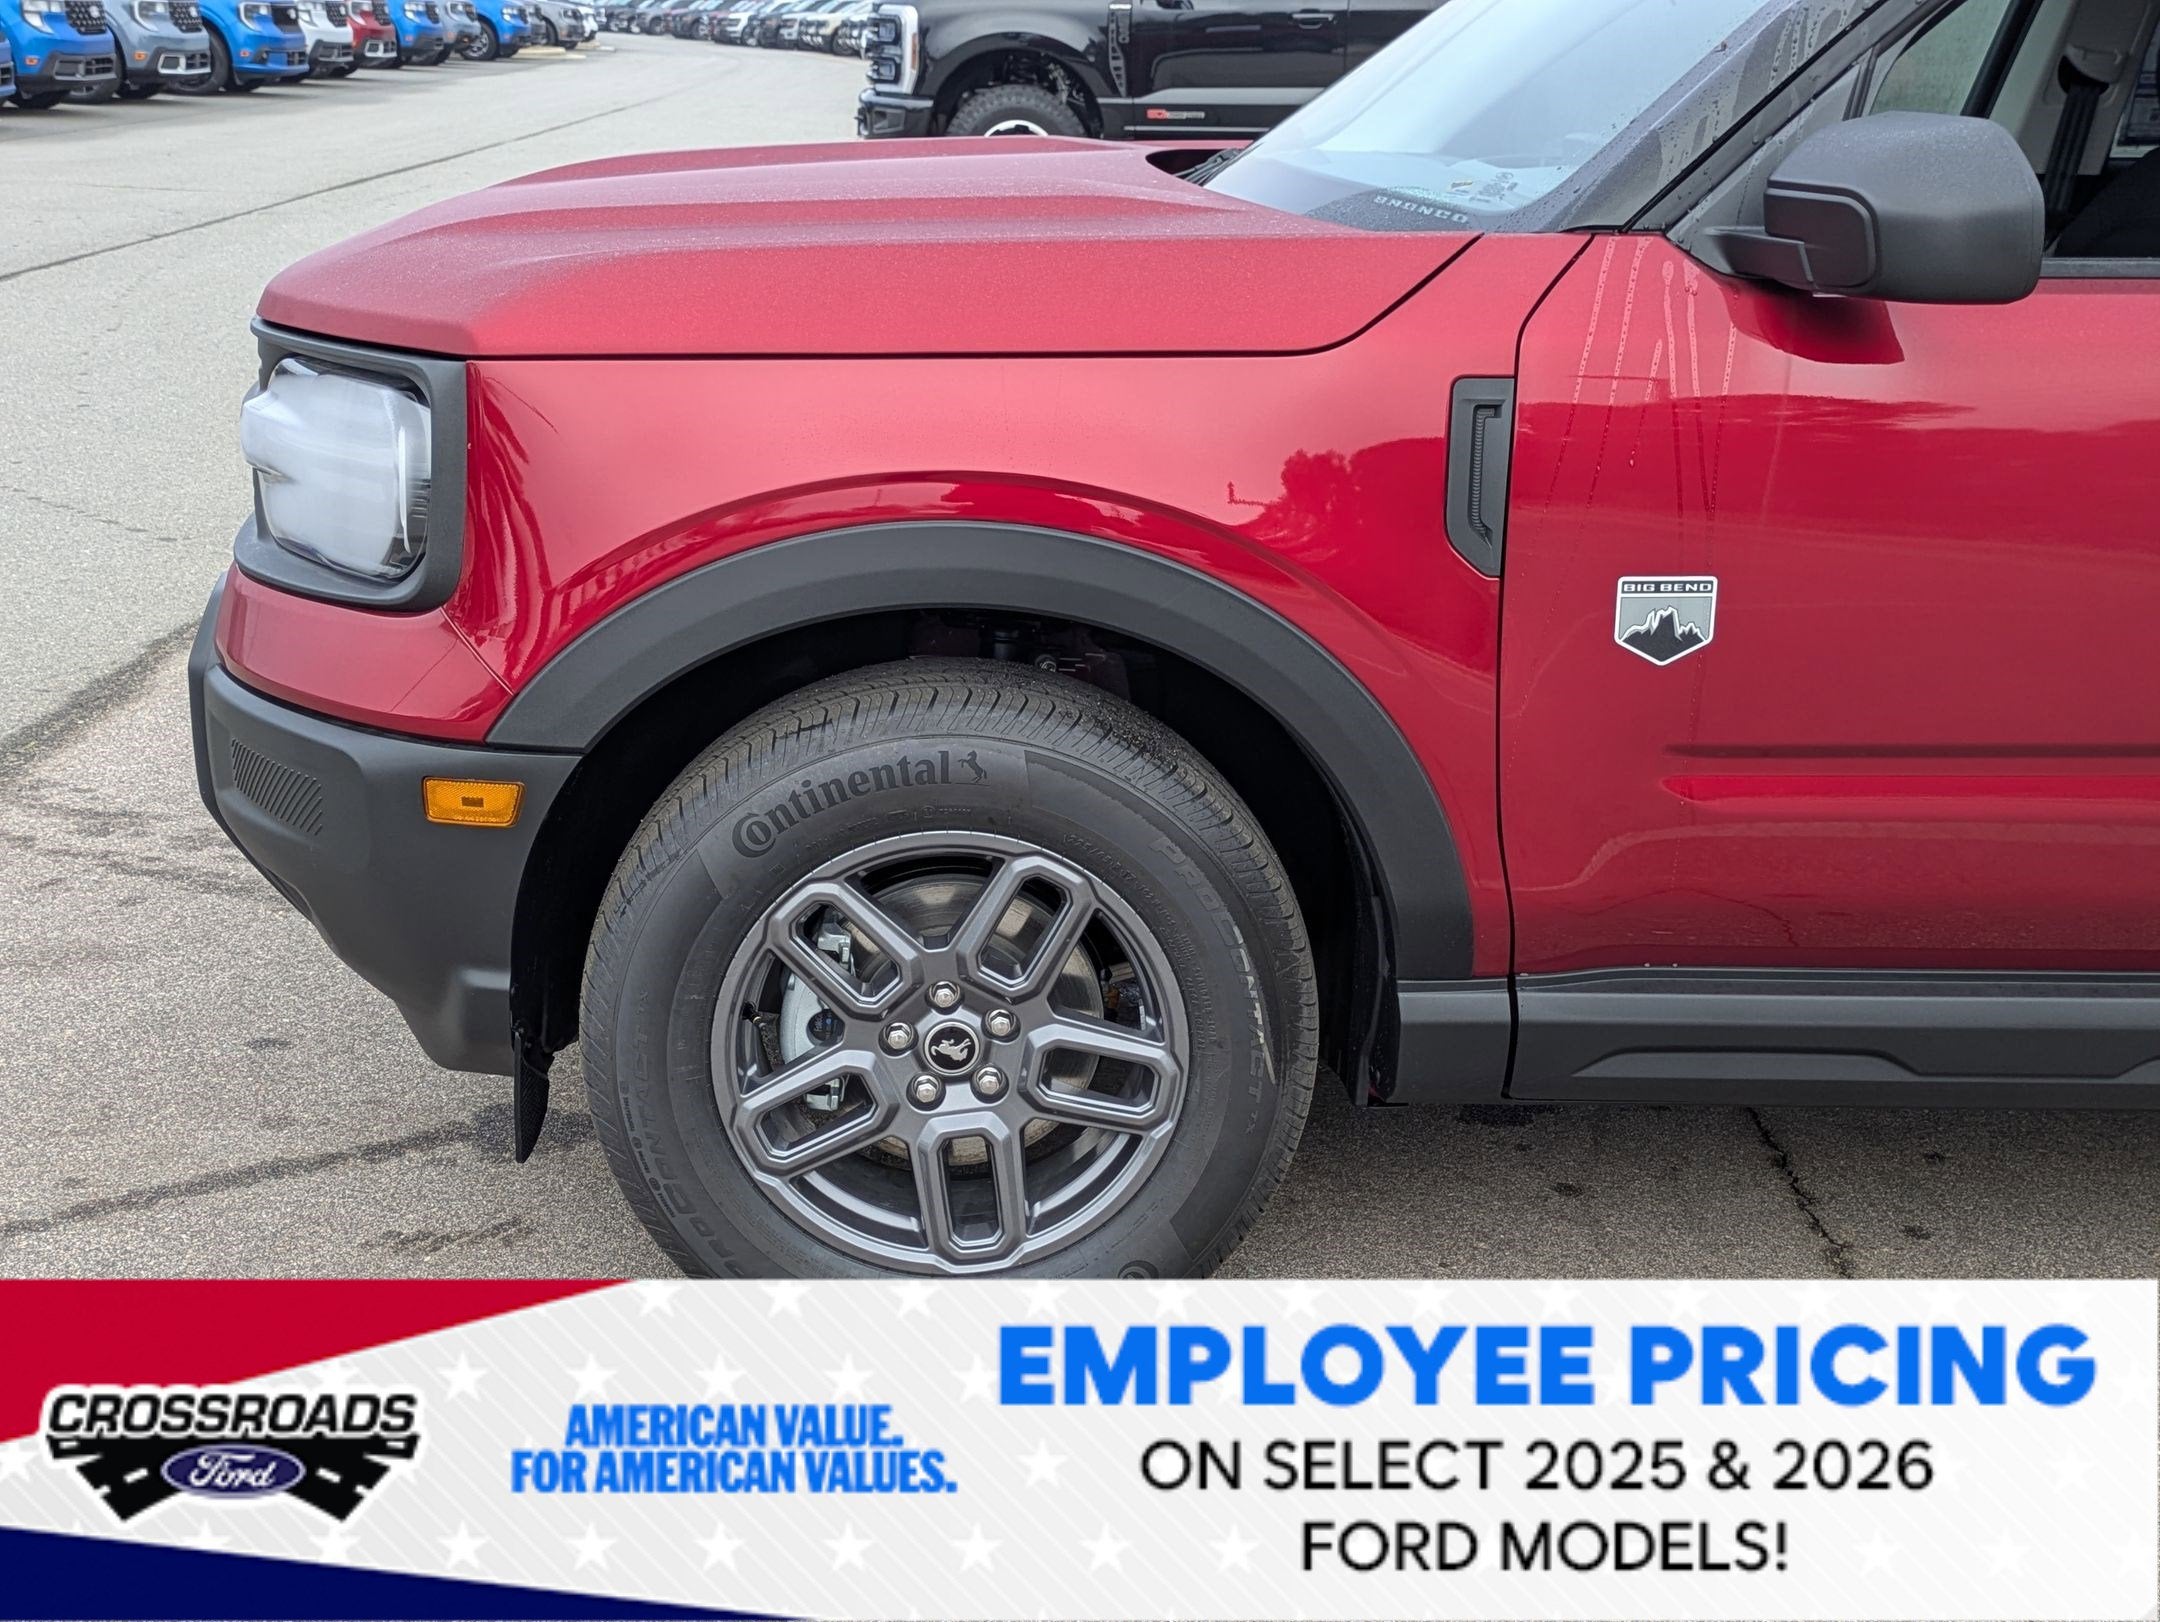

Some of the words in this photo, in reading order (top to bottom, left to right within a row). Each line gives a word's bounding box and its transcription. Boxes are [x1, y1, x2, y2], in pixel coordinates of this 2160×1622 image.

[1374, 195, 1469, 224] BRONCO
[1623, 583, 1655, 592] BIG
[1660, 583, 1712, 592] BEND
[731, 750, 952, 858] Continental
